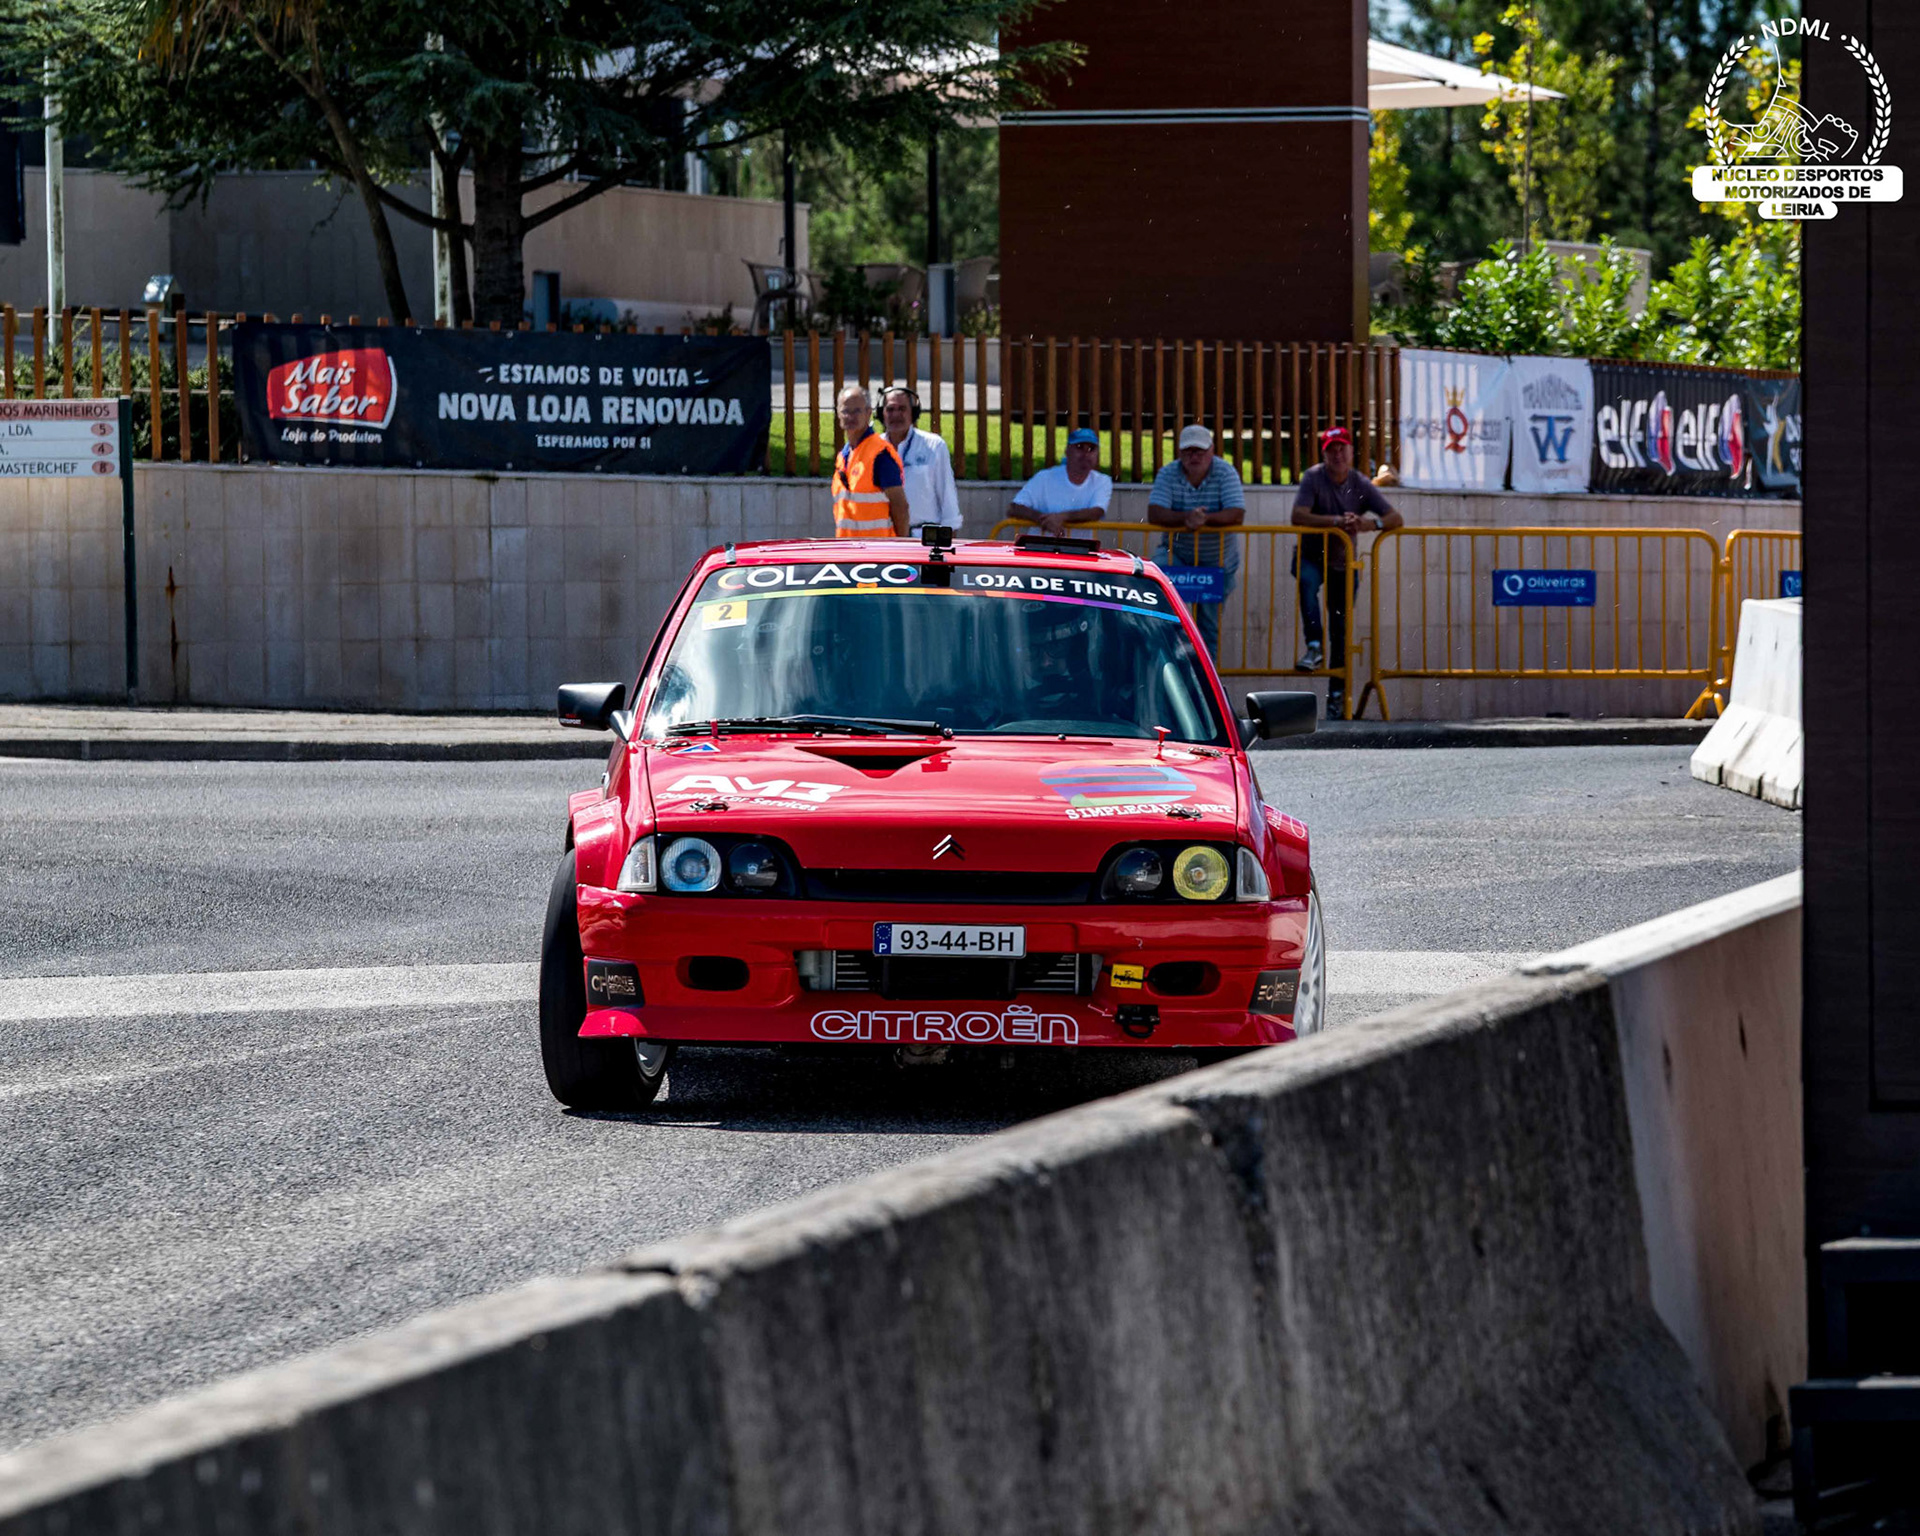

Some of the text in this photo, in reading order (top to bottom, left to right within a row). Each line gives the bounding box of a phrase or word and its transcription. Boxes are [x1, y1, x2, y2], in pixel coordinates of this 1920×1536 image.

[284, 357, 357, 386] Mais
[498, 363, 689, 387] ESTAMOS DE VOLTA
[281, 383, 378, 416] Sabor
[438, 392, 745, 425] NOVA LOJA RENOVADA
[0, 405, 110, 417] OS MARINHEIROS
[8, 425, 33, 436] LDA
[99, 424, 106, 435] 5
[1597, 399, 1648, 468] elf
[1676, 403, 1720, 471] elf
[97, 443, 105, 454] 4
[536, 435, 651, 449] ESPERAMOS POR SI
[717, 563, 918, 590] COLAÇO
[962, 574, 1159, 605] LOJA DE TINTAS
[718, 604, 732, 621] 2
[656, 792, 821, 812] Quality Car Services
[1064, 802, 1234, 821] SIMPLECARSNET
[879, 943, 887, 952] P
[900, 930, 1014, 952] 93-44-BH
